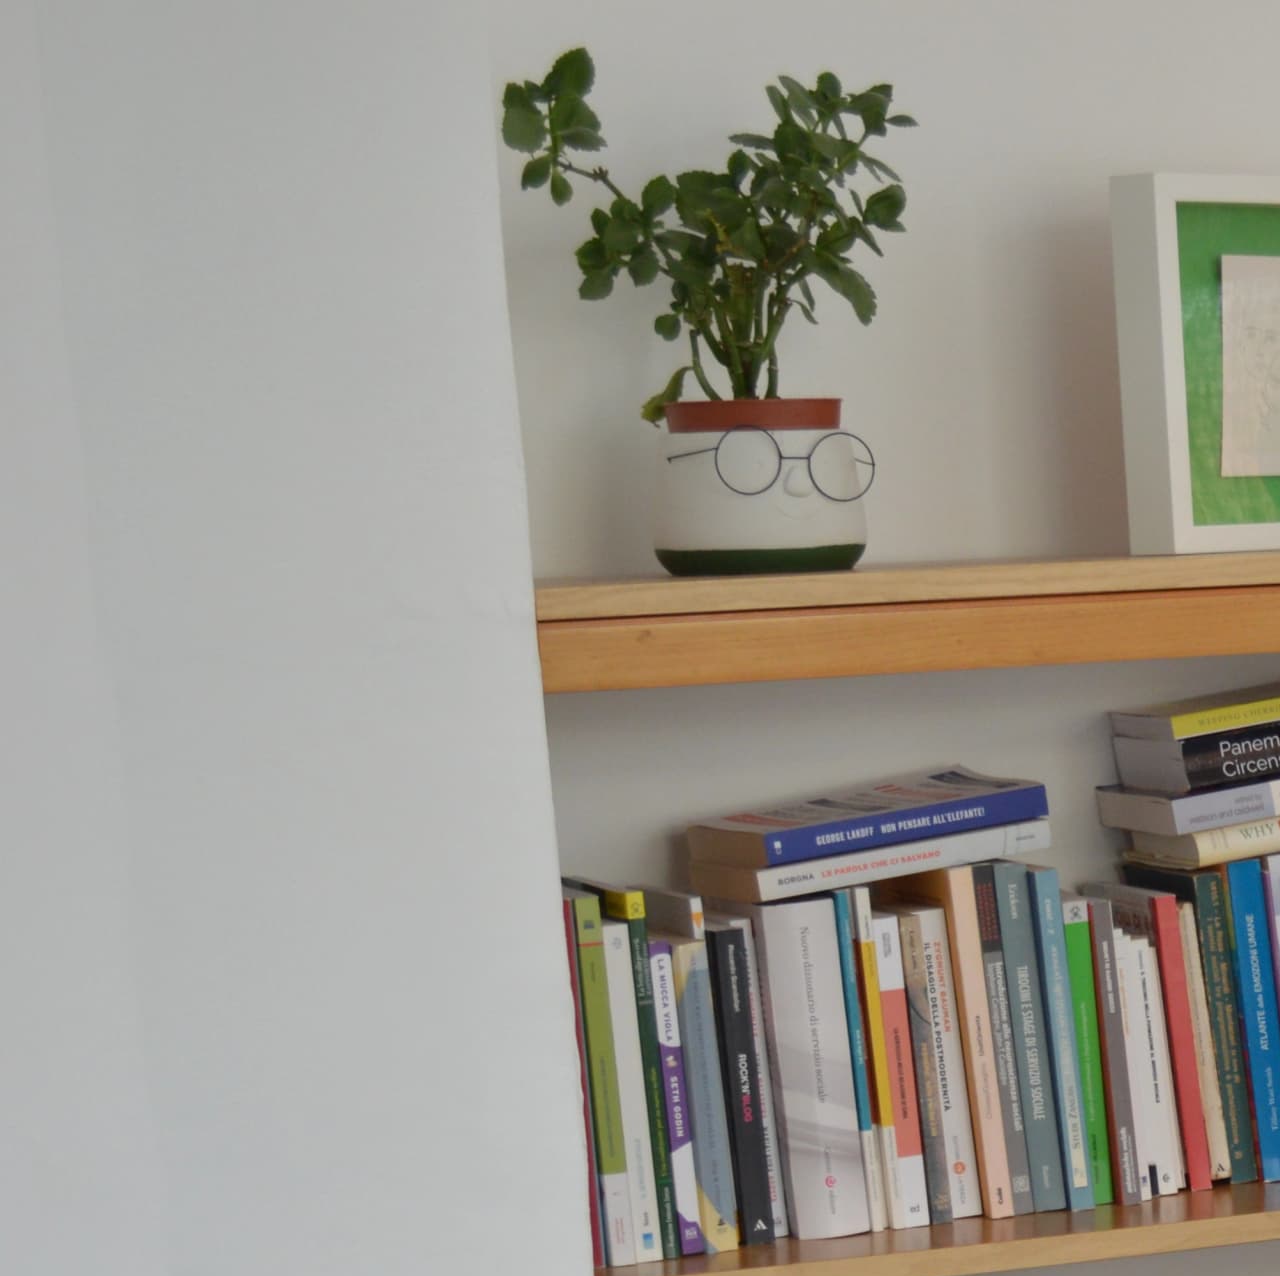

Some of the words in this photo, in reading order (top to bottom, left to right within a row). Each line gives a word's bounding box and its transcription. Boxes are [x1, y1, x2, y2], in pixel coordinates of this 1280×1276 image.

[815, 831, 844, 846] GEORGE
[880, 821, 897, 834] NON
[898, 815, 932, 831] PENSARE
[1238, 821, 1277, 840] WHY
[922, 942, 931, 950] IL
[1245, 913, 1258, 948] UMANE
[656, 957, 666, 972] LA
[796, 926, 812, 961] Nuovo
[806, 1015, 819, 1026] di
[923, 953, 936, 994] DISAGIO
[1249, 949, 1263, 992] EMOZIONI
[658, 974, 669, 1009] MUCCA
[1014, 965, 1031, 1002] TIROCINI
[929, 996, 941, 1028] DELLA
[1020, 1010, 1035, 1036] STAGE
[1256, 1009, 1270, 1050] ATLANTE
[1023, 1037, 1036, 1046] DI
[1024, 1048, 1041, 1085] SERVIZIO
[669, 1075, 680, 1102] SETH
[1029, 1086, 1045, 1121] SOCIALE
